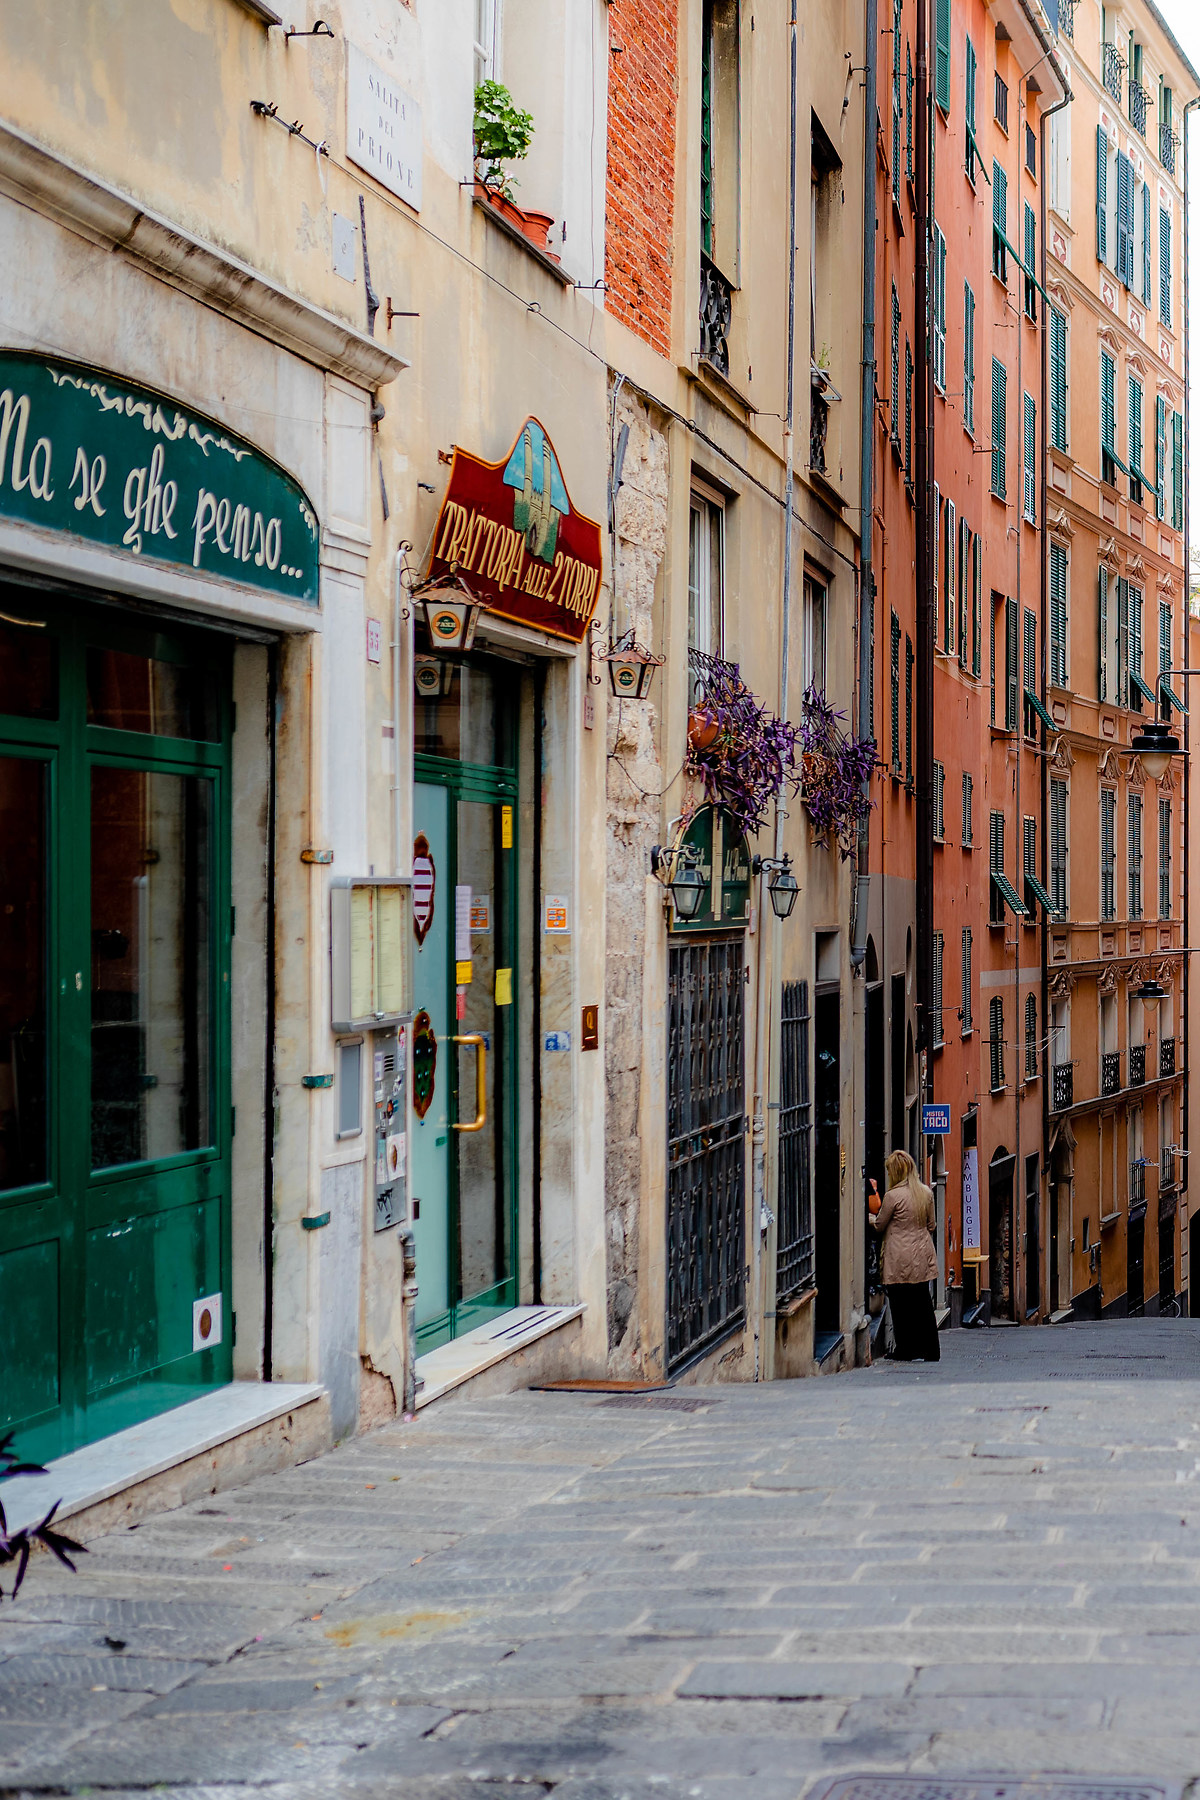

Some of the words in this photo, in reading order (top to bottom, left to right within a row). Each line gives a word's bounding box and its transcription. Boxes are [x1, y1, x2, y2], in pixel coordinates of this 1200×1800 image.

[368, 74, 407, 121] SALITA
[378, 115, 395, 139] DEL
[358, 127, 413, 189] PRIONE
[68, 446, 107, 518] se
[123, 443, 179, 555] ghe
[435, 500, 527, 592] TRATTORIA
[520, 562, 550, 599] ALLE
[545, 551, 564, 602] 2
[557, 556, 599, 622] TORRI
[923, 1117, 948, 1128] TACO
[963, 1151, 974, 1246] HAMBURGER
